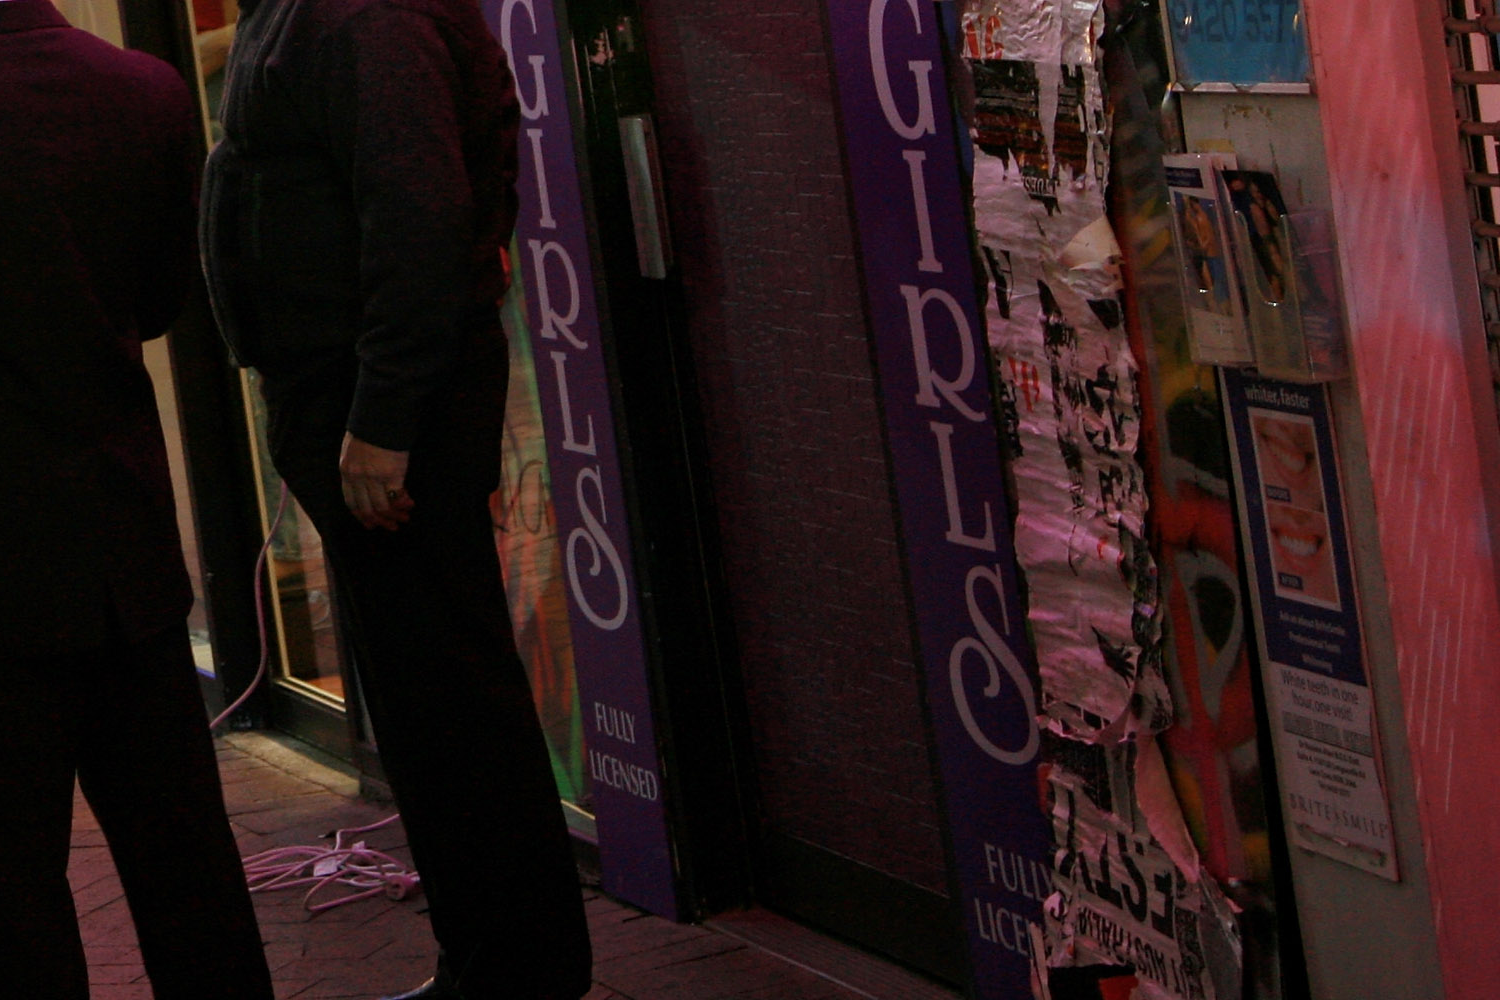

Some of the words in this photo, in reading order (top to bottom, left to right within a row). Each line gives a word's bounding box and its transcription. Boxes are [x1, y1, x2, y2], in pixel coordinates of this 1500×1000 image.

[593, 701, 637, 746] FULLY
[588, 748, 659, 801] LICENSED
[983, 841, 1055, 904] FULLY
[973, 896, 1034, 961] LICE
